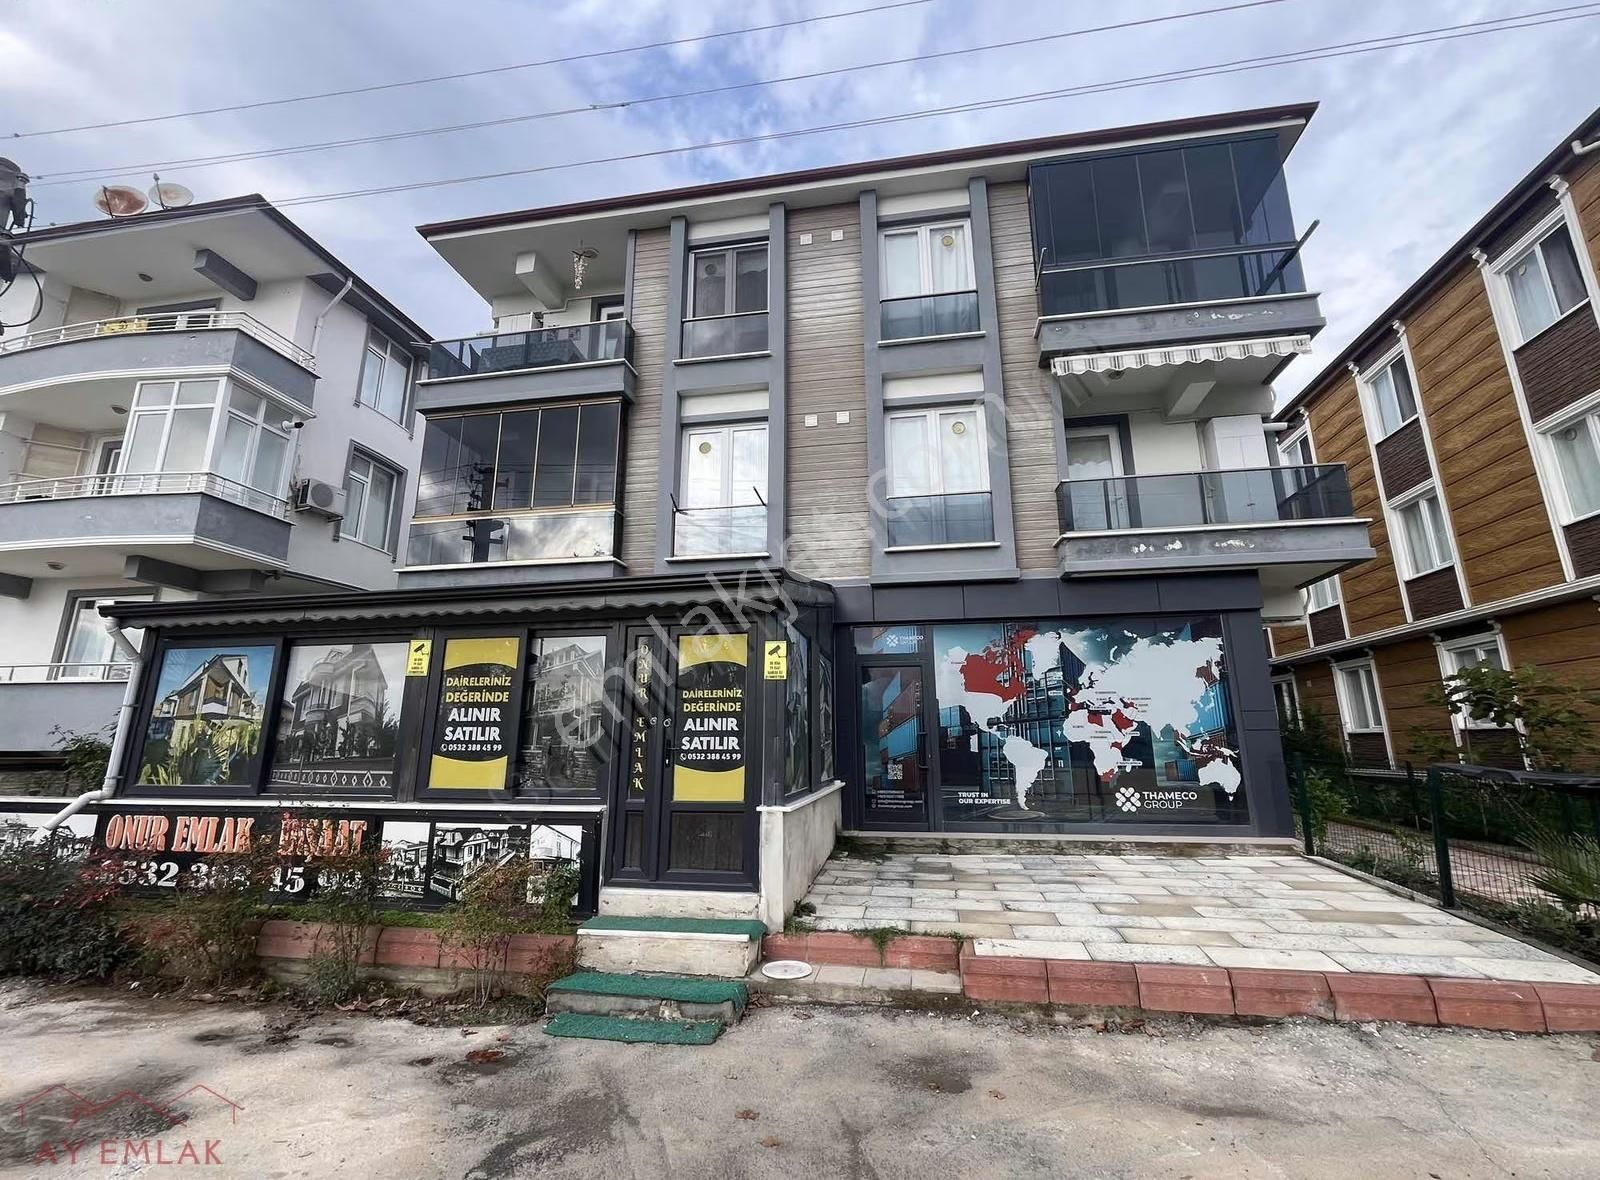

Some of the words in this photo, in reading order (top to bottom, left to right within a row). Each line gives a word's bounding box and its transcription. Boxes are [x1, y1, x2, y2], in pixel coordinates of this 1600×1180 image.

[638, 645, 649, 700] ONUR
[446, 675, 512, 687] DAİRELERİNİZ
[445, 689, 510, 703] DEĞERİNDE
[682, 688, 743, 698] DAİRELERİNİZ
[683, 701, 742, 712] DEĞERİNDE
[448, 708, 501, 722] ALINIR
[683, 718, 739, 731] ALINIR
[444, 726, 501, 741] SATILIR
[681, 736, 740, 750] SATILIR
[633, 717, 648, 790] EMLAK
[1142, 791, 1198, 800] THAMECO
[1143, 800, 1183, 809] GROUP
[105, 814, 170, 851] ONUR
[171, 816, 255, 853] EMLAK
[95, 859, 179, 887] 532
